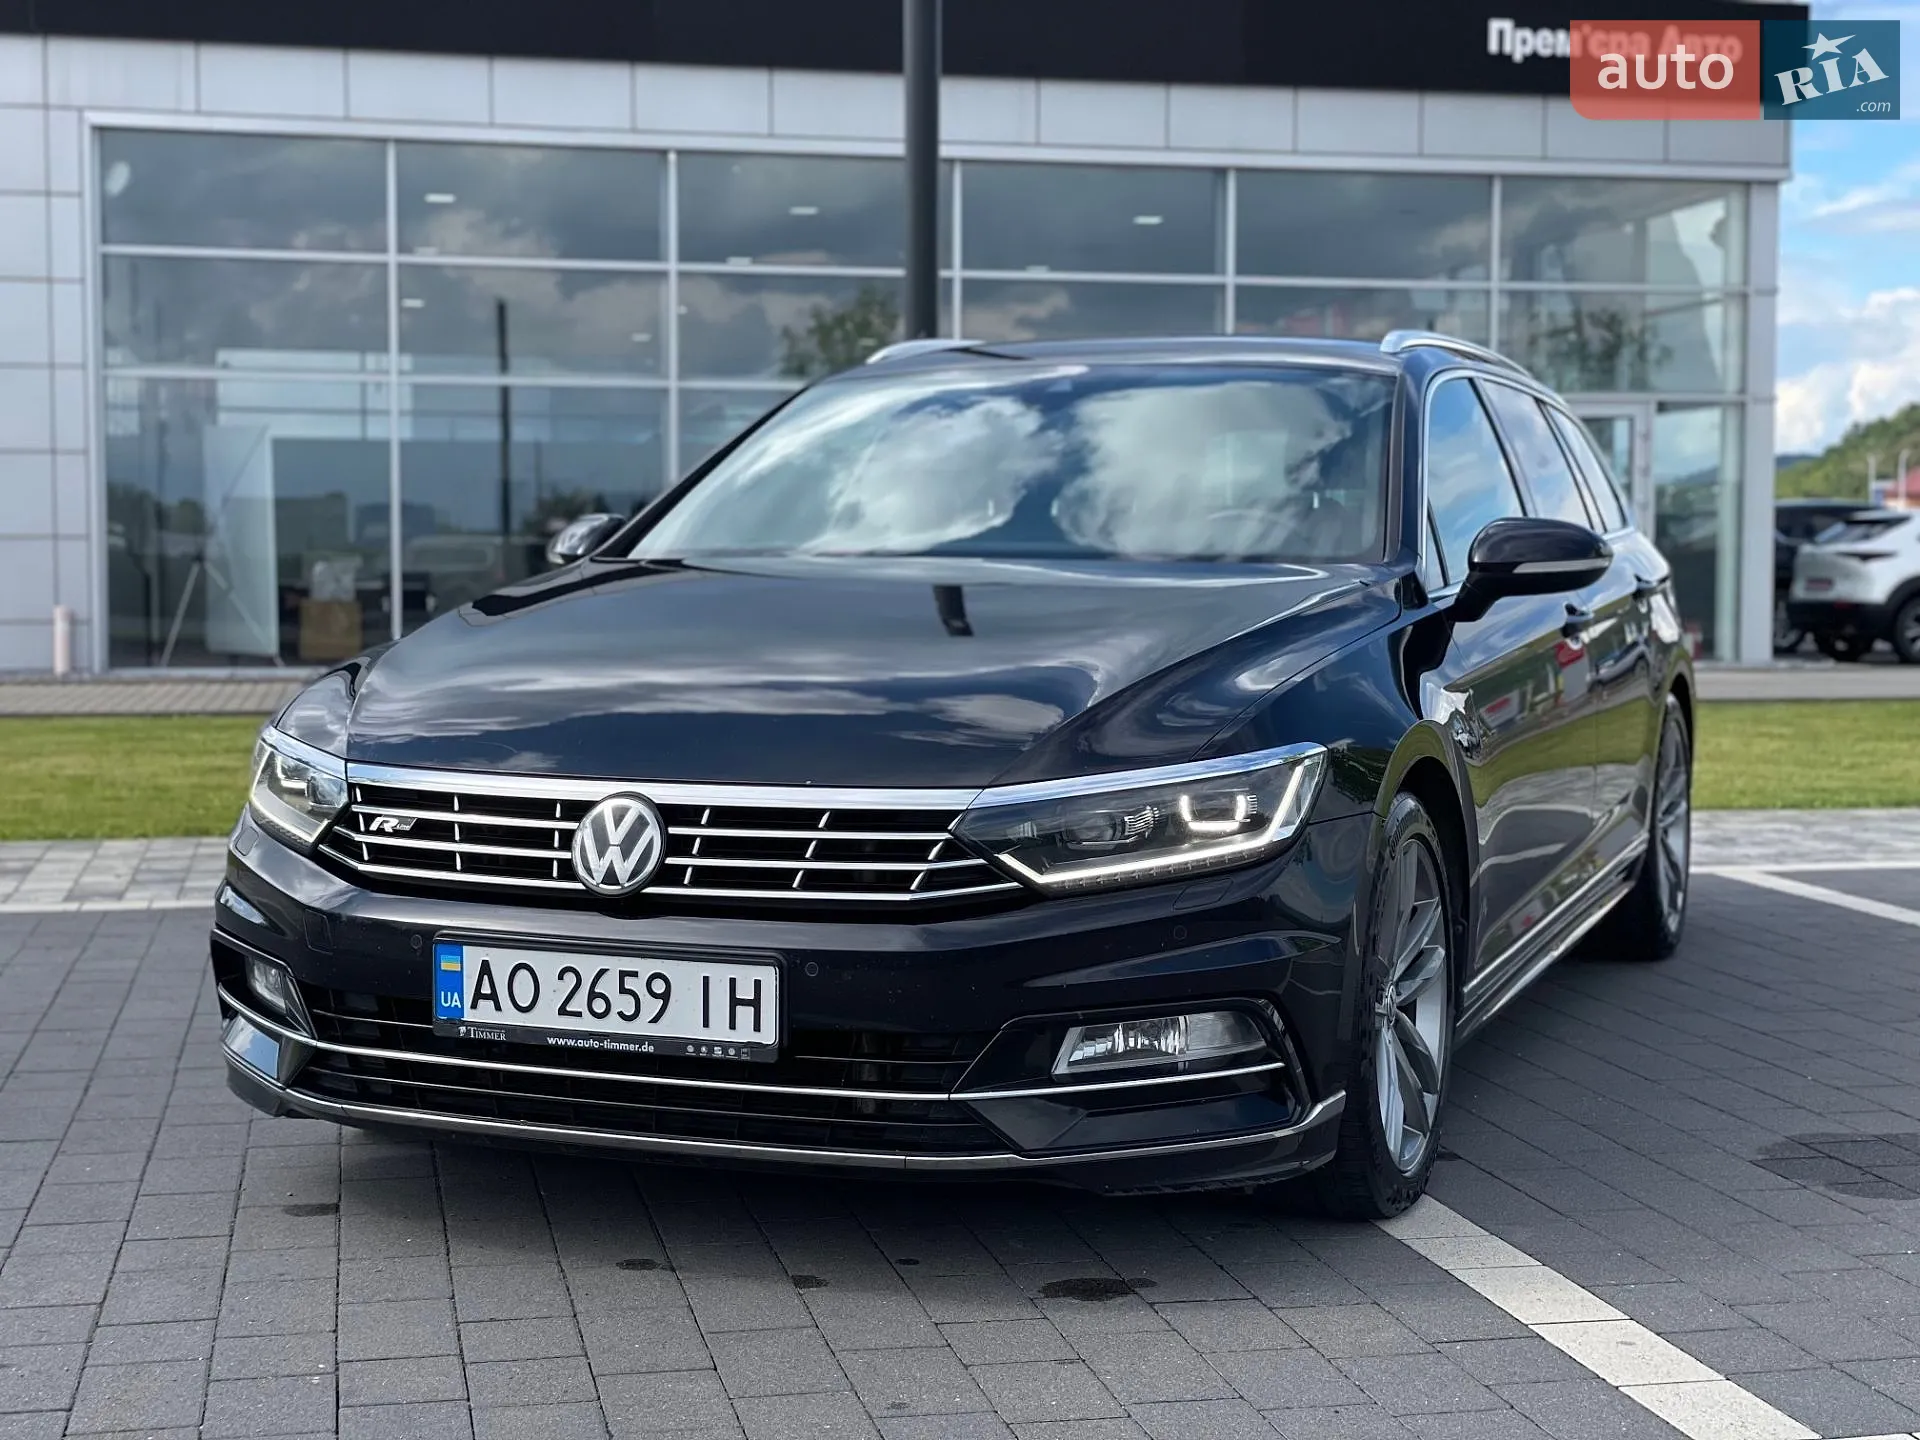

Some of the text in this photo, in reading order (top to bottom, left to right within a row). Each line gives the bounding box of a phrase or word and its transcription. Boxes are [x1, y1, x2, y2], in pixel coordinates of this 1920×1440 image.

[440, 991, 462, 1009] UA
[469, 959, 762, 1032] AO 2659 IH
[546, 1035, 655, 1053] www.auto-timmer.de
